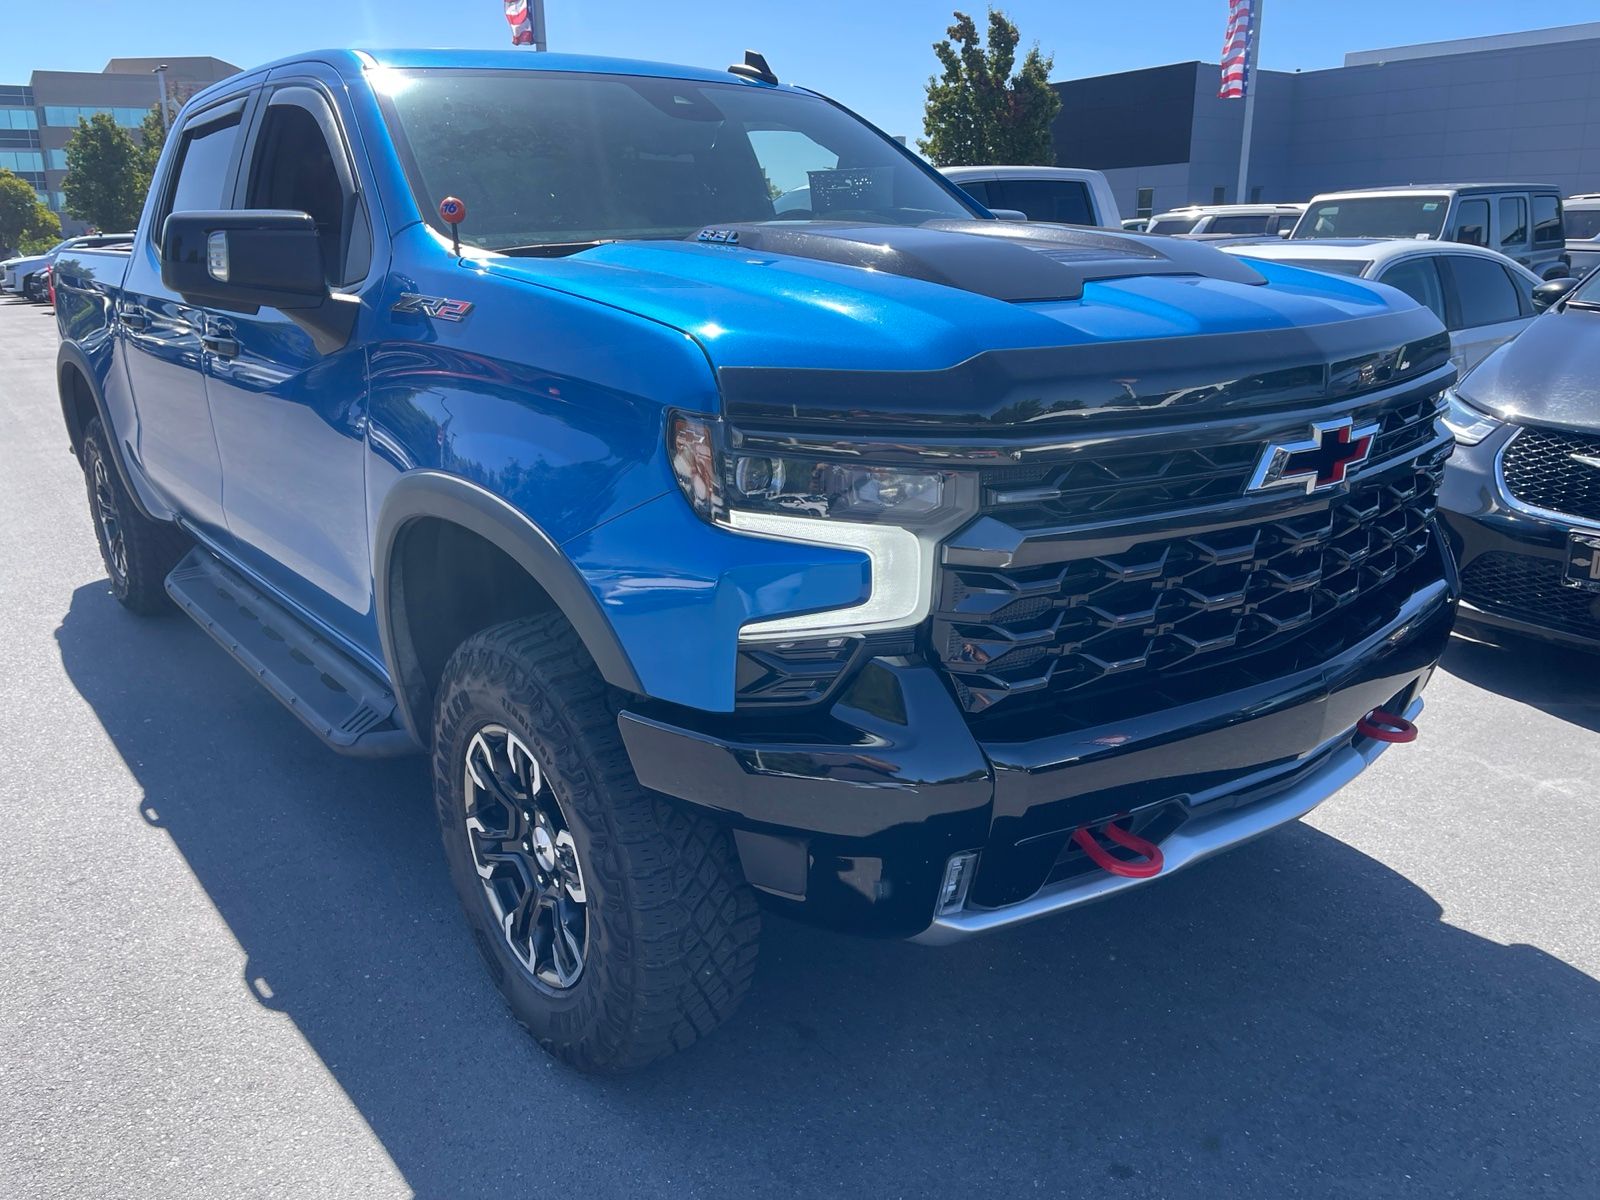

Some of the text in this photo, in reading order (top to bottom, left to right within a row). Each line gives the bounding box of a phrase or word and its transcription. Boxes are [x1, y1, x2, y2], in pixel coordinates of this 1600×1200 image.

[443, 202, 458, 215] 76
[391, 292, 473, 322] ZR2
[501, 696, 553, 766] TERRITORY
